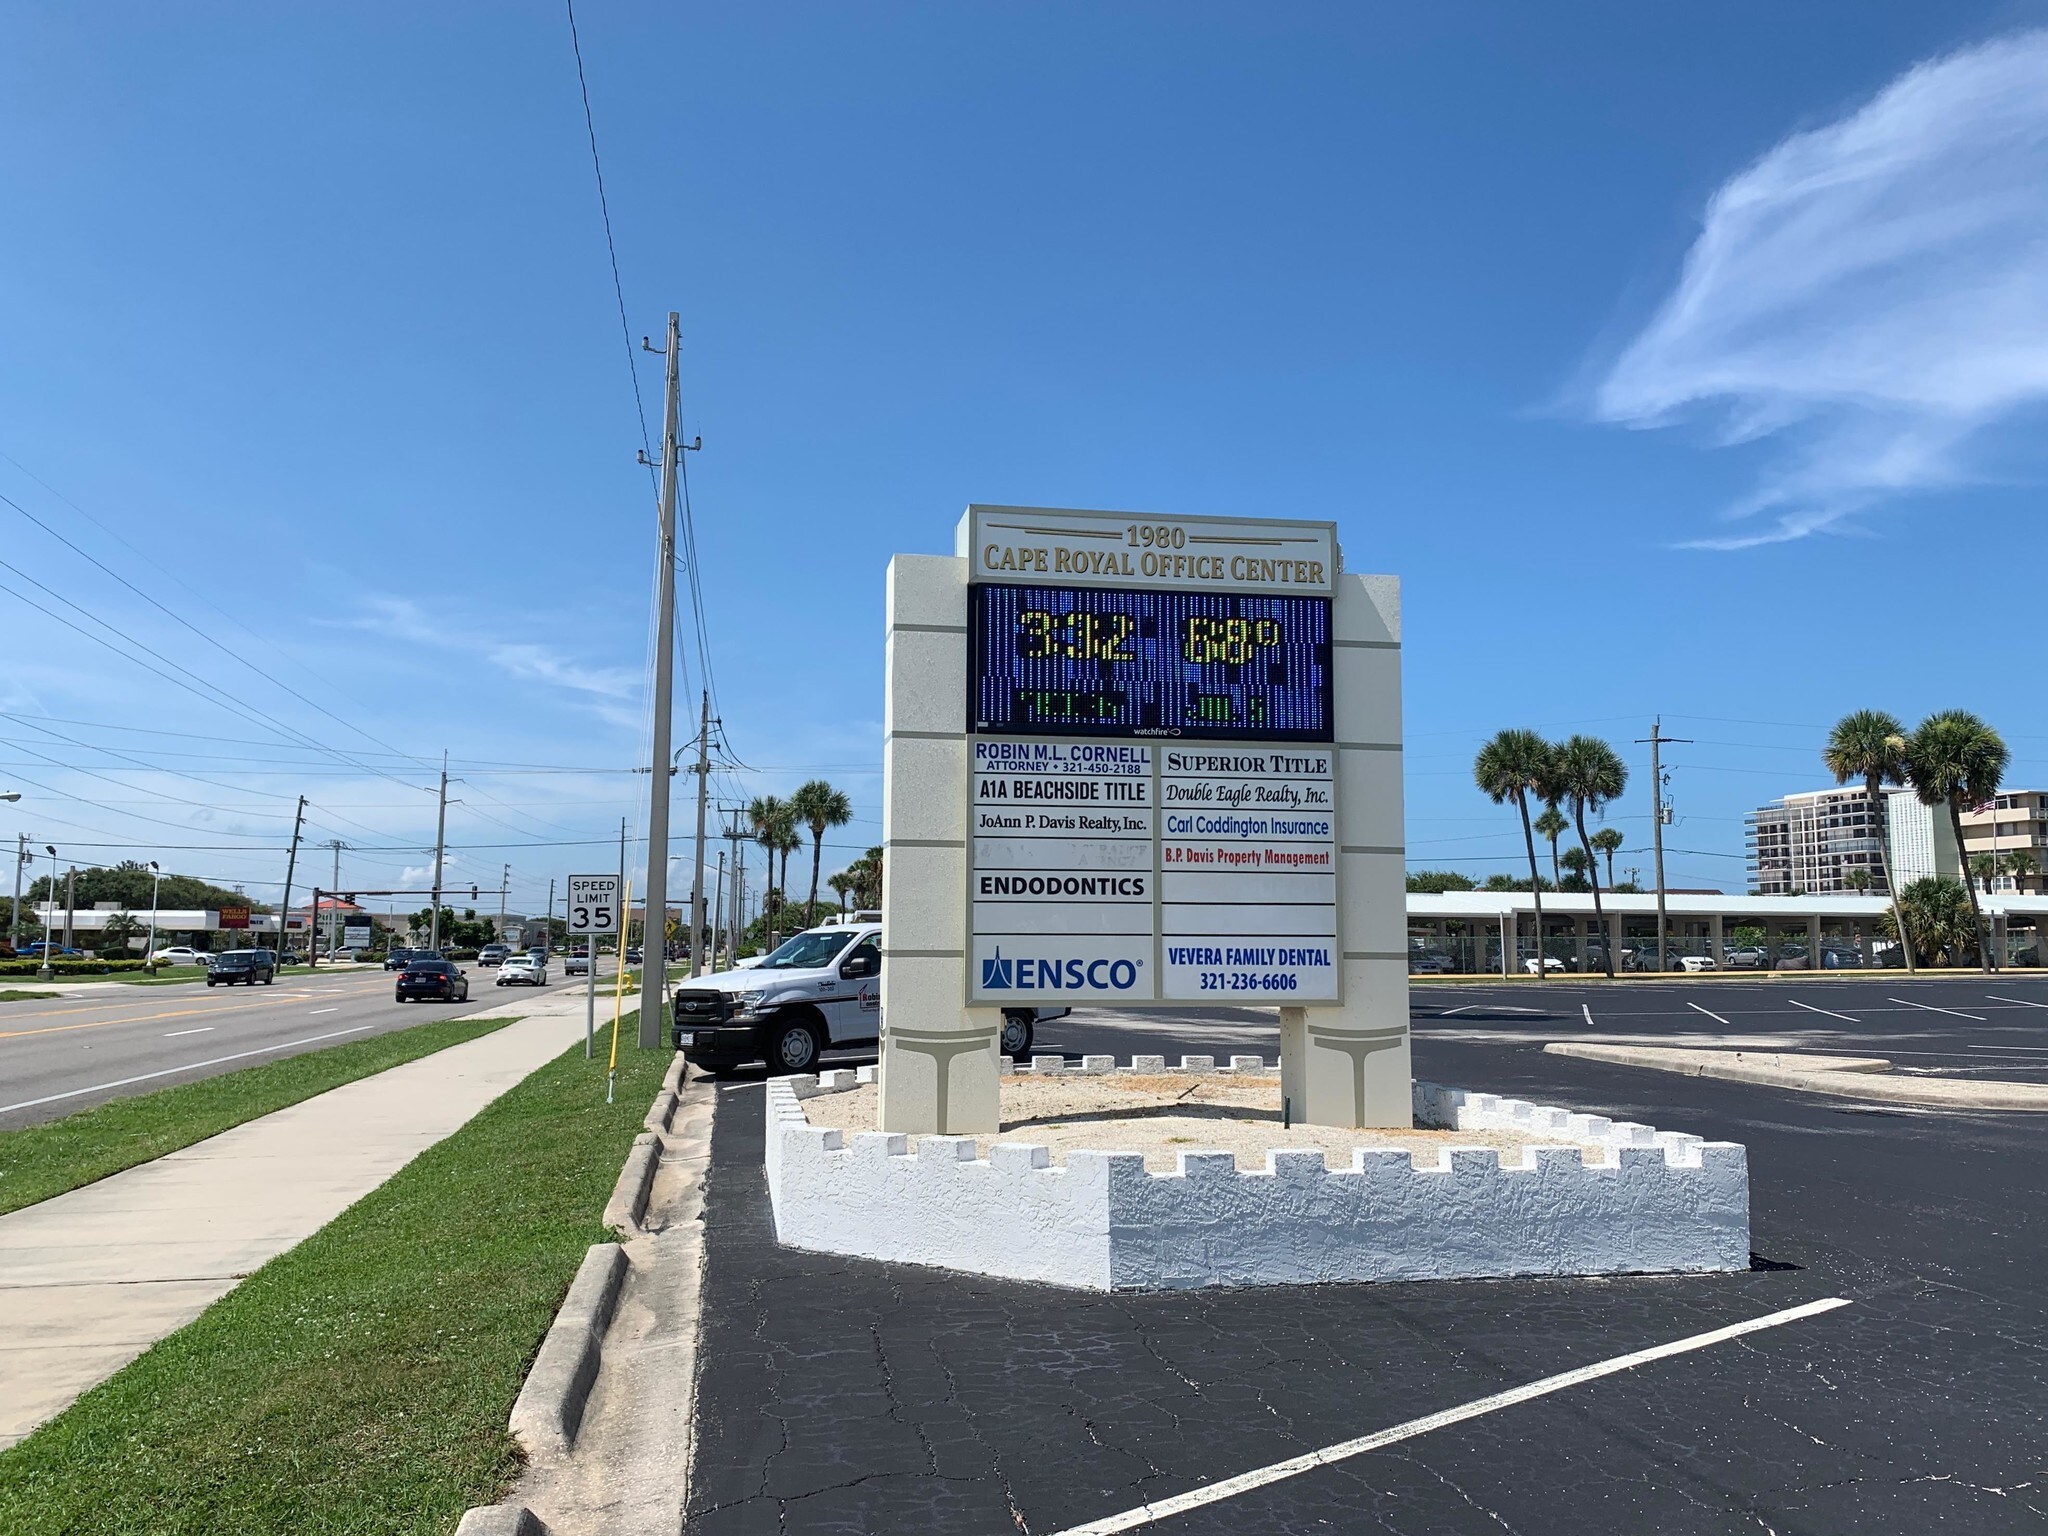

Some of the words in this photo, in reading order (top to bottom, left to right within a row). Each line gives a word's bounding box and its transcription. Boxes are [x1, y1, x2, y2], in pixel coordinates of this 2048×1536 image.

[1127, 525, 1185, 549] 1980
[984, 544, 1048, 572] CAPE
[1054, 547, 1135, 576] ROYAL
[1140, 551, 1225, 580] OFFICE
[1230, 555, 1325, 584] CENTER
[1133, 727, 1169, 736] watchfire
[975, 743, 1030, 760] ROBIN
[1034, 744, 1067, 761] M.L.
[1071, 746, 1151, 764] CORNELL
[1168, 752, 1267, 773] SUPERIOR
[1270, 755, 1327, 774] TITLE
[986, 760, 1049, 772] ATTORNEY
[1063, 763, 1141, 775] 321-450-2188
[979, 779, 1008, 799] A1A
[1013, 780, 1099, 800] BEACHSIDE
[1104, 782, 1146, 801] TITLE
[1166, 782, 1212, 802] Double
[1216, 783, 1252, 808] Eagle
[1255, 784, 1302, 809] Realty,
[1304, 787, 1329, 804] Inc.
[979, 814, 1022, 829] JoAnn
[1025, 814, 1036, 829] P.
[1038, 815, 1076, 830] Davis
[1079, 815, 1122, 833] Realty,
[1123, 816, 1147, 831] Inc.
[1167, 815, 1193, 833] Carl
[1196, 816, 1268, 838] Coddington
[1271, 817, 1329, 835] Insurance
[1165, 847, 1184, 863] B.P.
[1186, 847, 1214, 863] Davis
[1217, 848, 1262, 867] Property
[1264, 849, 1330, 867] Management
[573, 881, 616, 891] SPEED
[980, 876, 1145, 896] ENDODONTICS
[577, 893, 611, 903] LIMIT
[317, 913, 346, 921] Puli
[572, 907, 612, 928] 35
[1168, 947, 1223, 966] VEVERA
[1226, 948, 1275, 967] FAMILY
[1278, 949, 1331, 967] DENTAL
[1200, 972, 1298, 991] 321-236-6606
